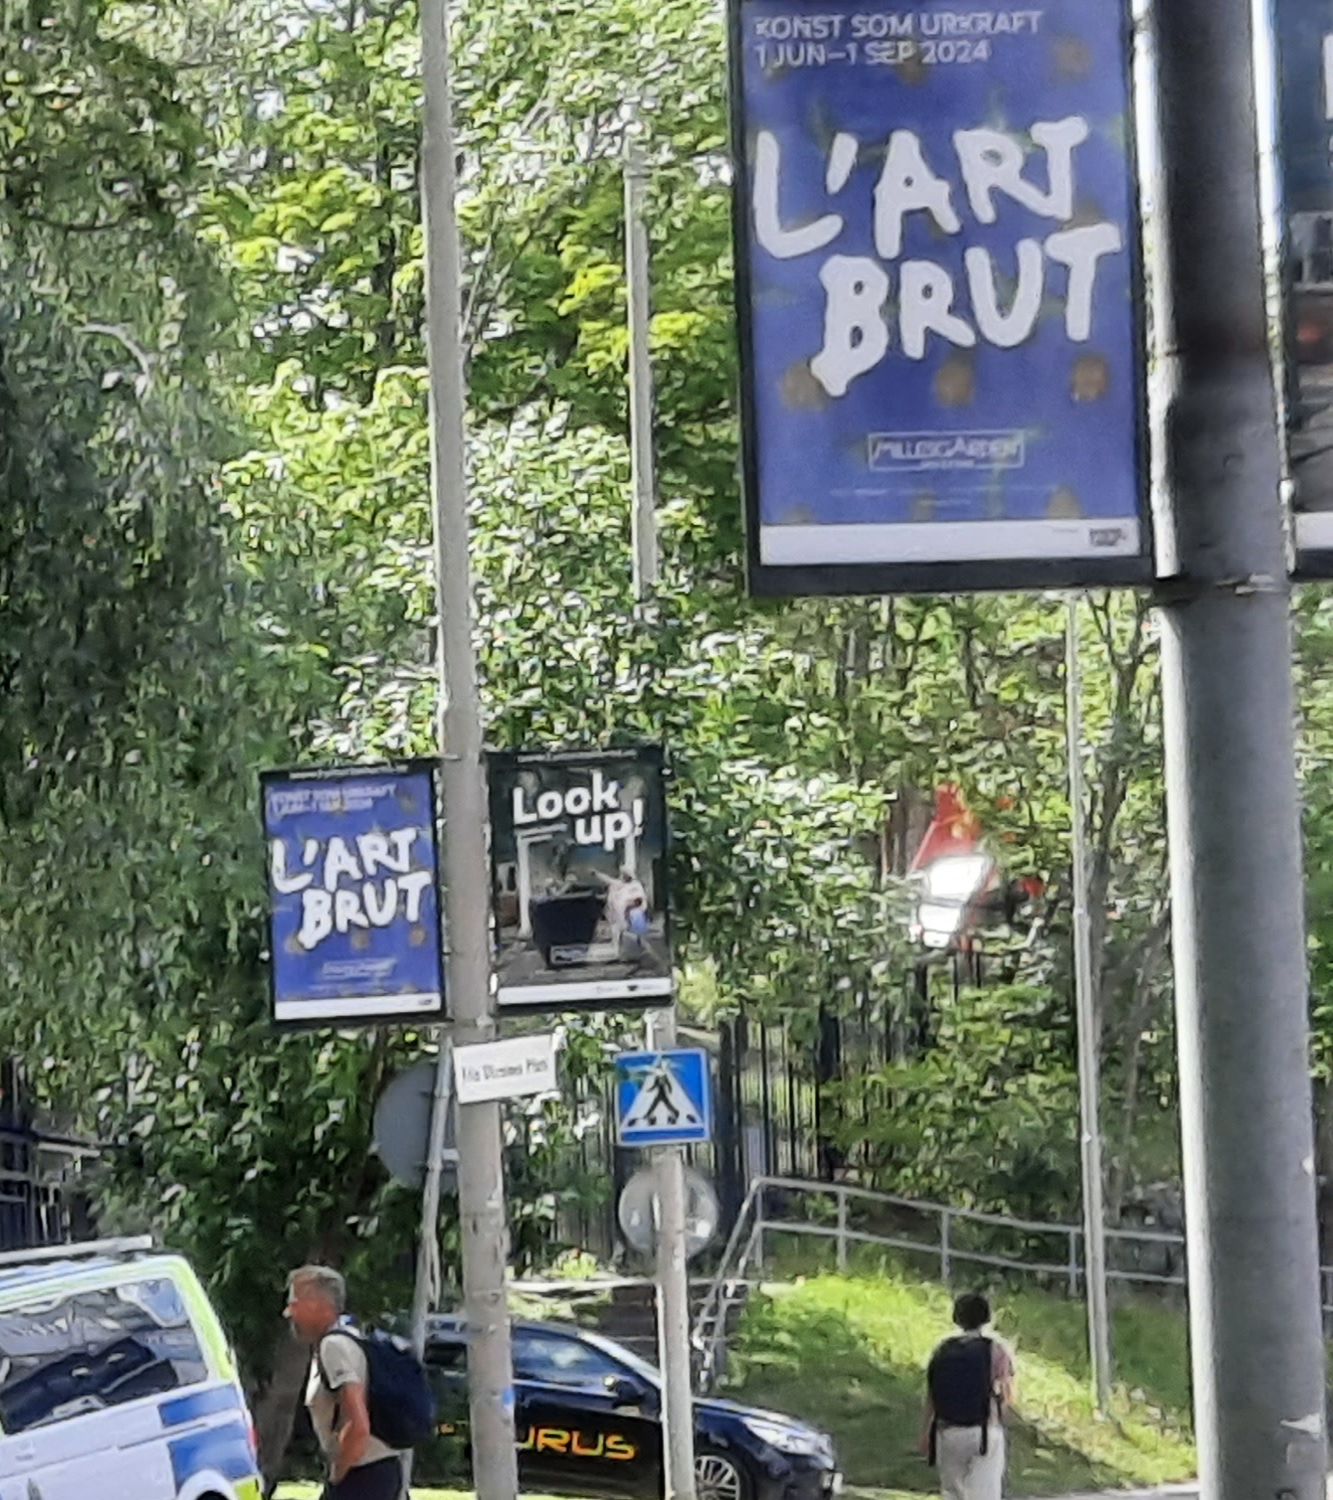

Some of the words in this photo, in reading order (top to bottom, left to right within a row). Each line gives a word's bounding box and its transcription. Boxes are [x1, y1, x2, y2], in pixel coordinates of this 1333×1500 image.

[754, 14, 845, 40] KONST
[851, 13, 913, 38] SOM
[919, 10, 1043, 36] URKRAFT
[756, 44, 767, 68] 1
[865, 41, 915, 64] SEP
[921, 38, 991, 63] 2024
[753, 116, 1088, 259] L'ART
[811, 224, 1121, 397] BRUT
[512, 769, 620, 824] Look
[574, 798, 643, 851] up!
[271, 827, 417, 894] L'ART
[297, 870, 432, 950] BRUT
